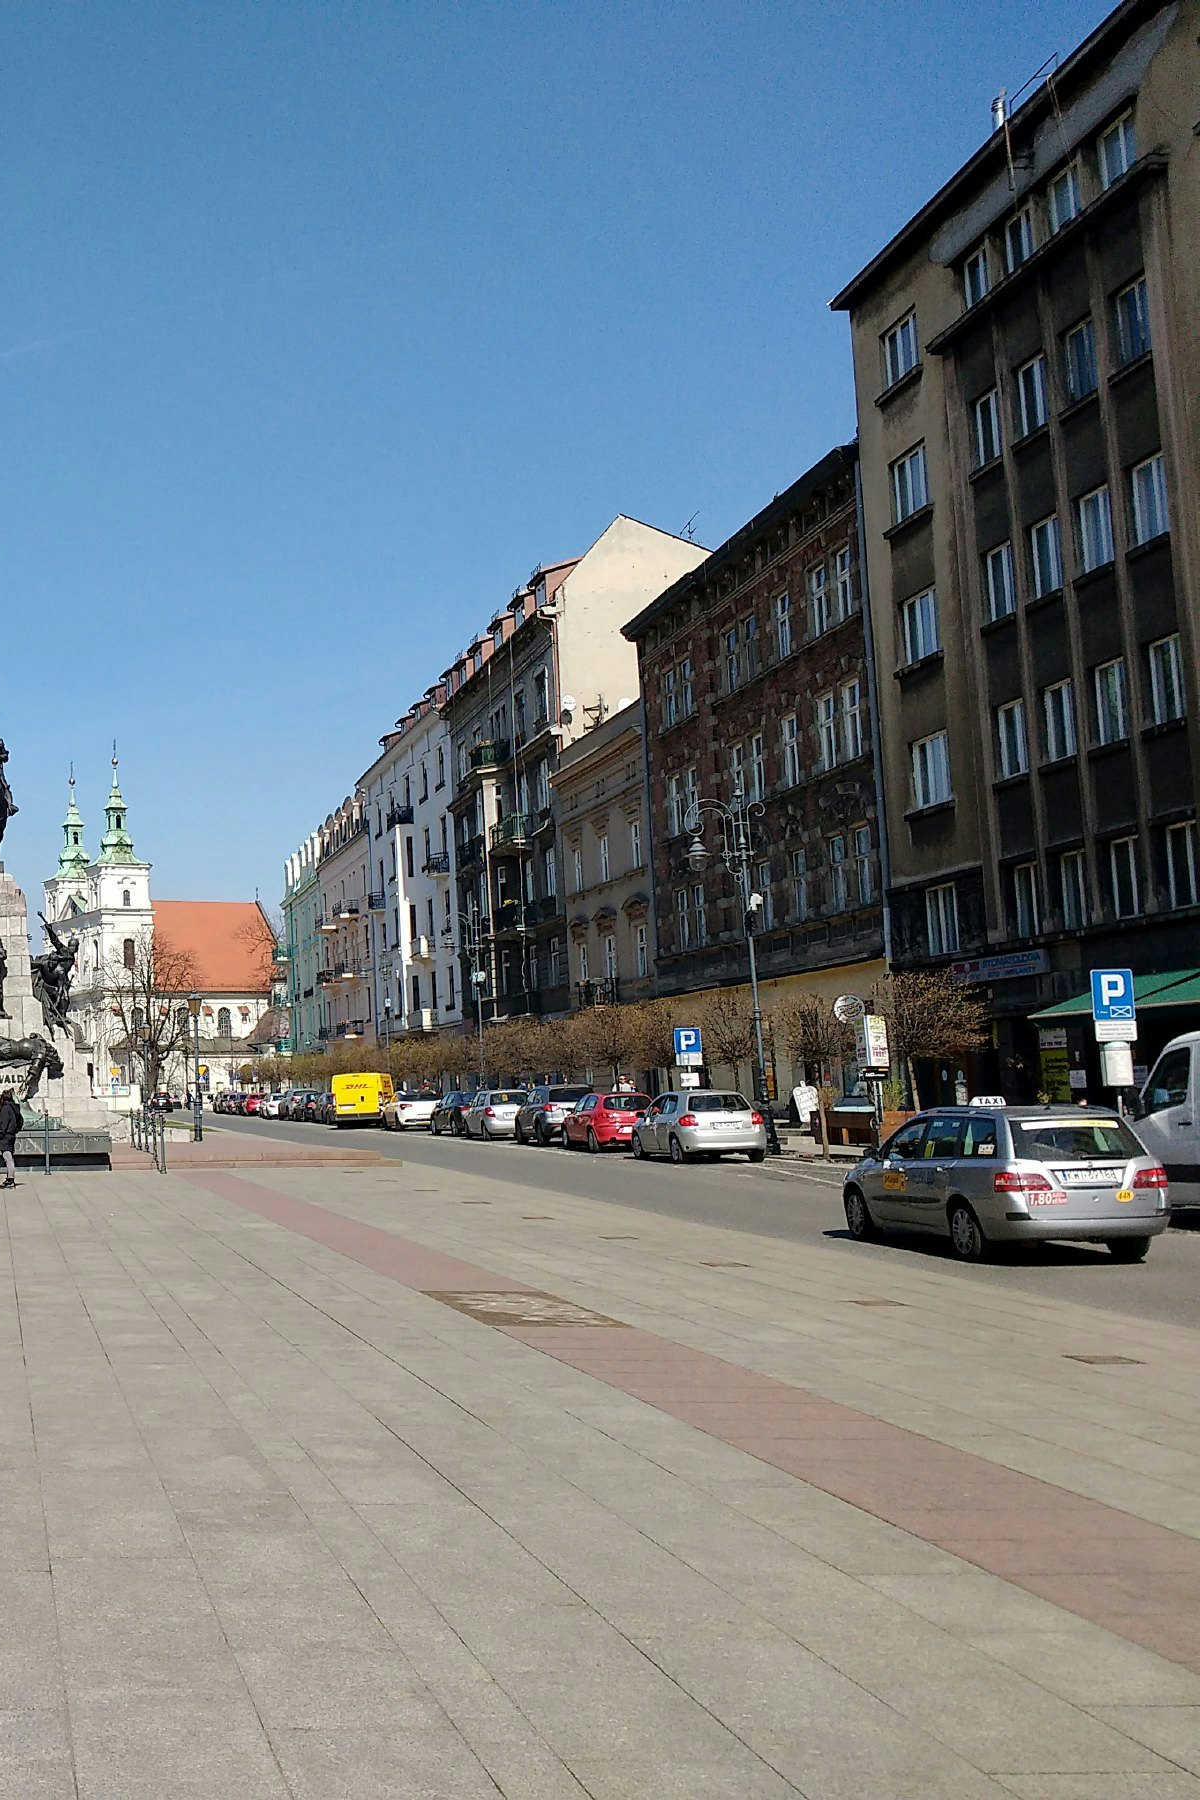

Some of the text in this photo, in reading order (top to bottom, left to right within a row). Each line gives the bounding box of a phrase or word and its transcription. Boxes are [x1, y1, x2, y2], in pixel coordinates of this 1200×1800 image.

[1100, 974, 1125, 1006] P
[680, 1030, 696, 1051] P
[978, 1097, 1004, 1105] TAXI
[1029, 1193, 1052, 1206] 1,80
